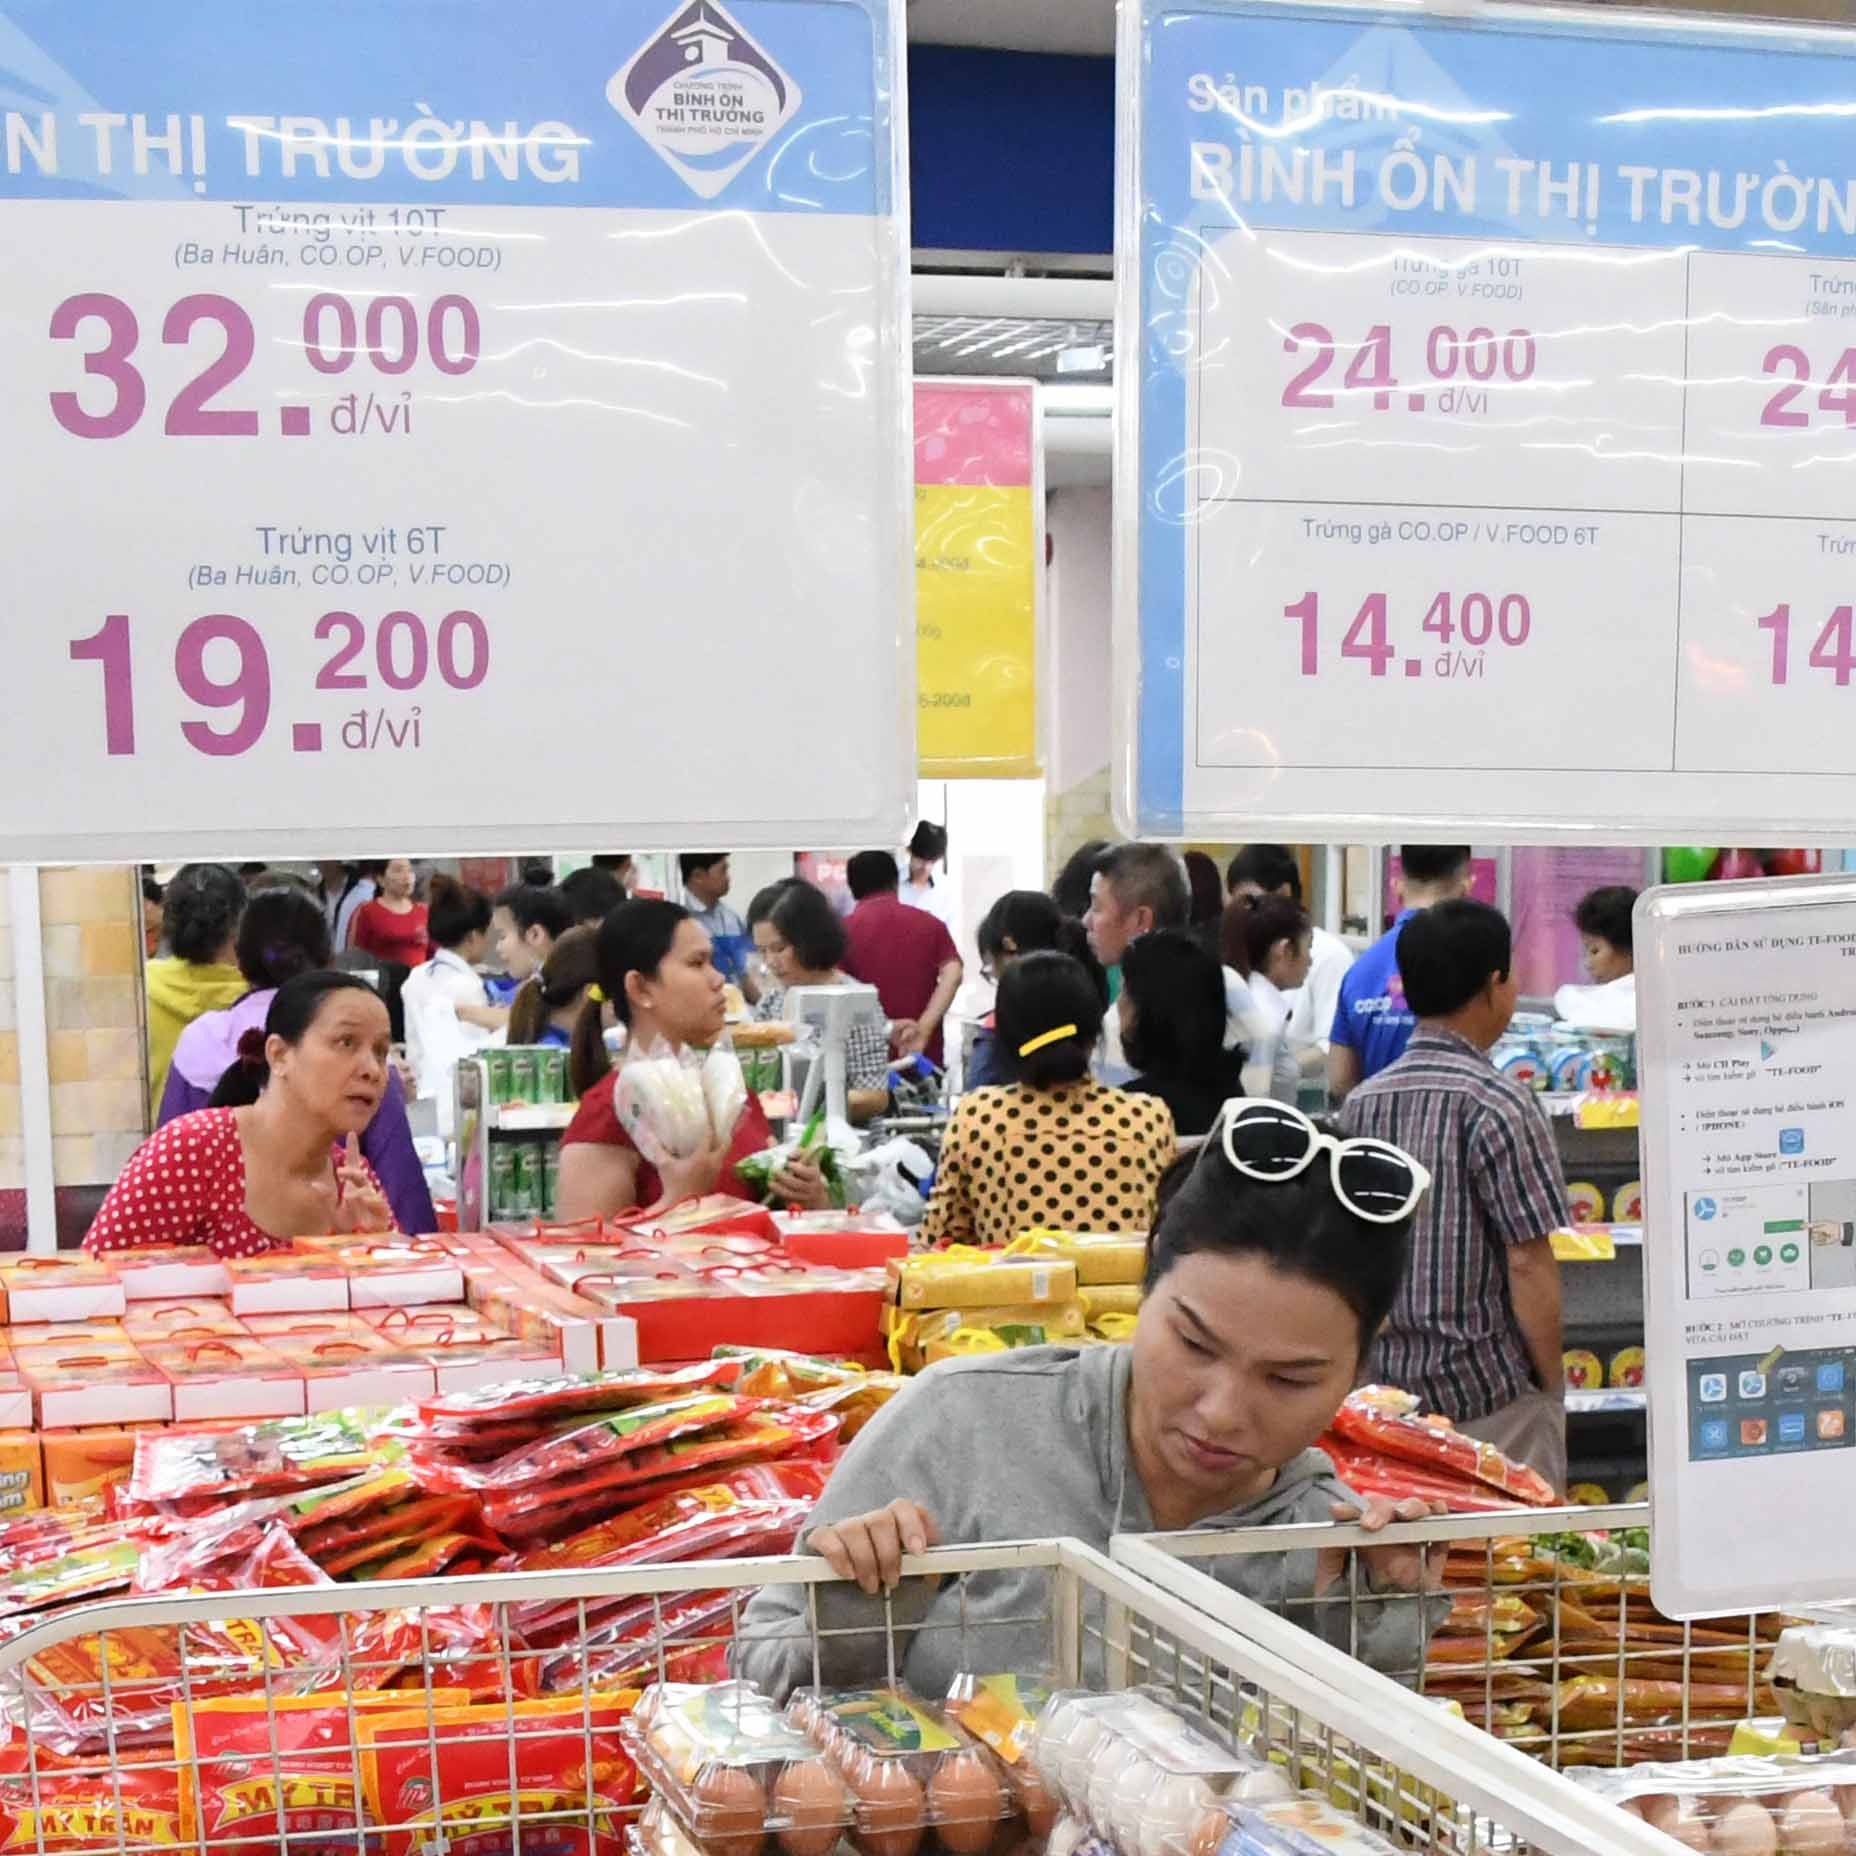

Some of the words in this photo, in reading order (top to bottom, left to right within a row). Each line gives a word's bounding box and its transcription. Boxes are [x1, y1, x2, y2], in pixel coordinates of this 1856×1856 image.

[1187, 72, 1268, 113] Sản
[79, 112, 207, 193] THỊ
[228, 103, 582, 183] TRƯỜNG
[1189, 128, 1355, 207] BÌNH
[1379, 127, 1479, 214] ỔN
[1496, 158, 1601, 236] THỊ
[233, 206, 331, 242] Trứng
[341, 209, 376, 242] vịt
[389, 209, 447, 238] 10T
[175, 244, 214, 269] (Ba
[398, 246, 503, 271] V.FOOD)
[49, 292, 482, 438] 32.000
[330, 390, 413, 438] đ/vỉ
[254, 525, 352, 562] Trứng
[362, 527, 397, 561] vịt
[406, 526, 448, 555] 6T
[1302, 518, 1364, 544] Trứng
[1368, 521, 1393, 546] gà
[1397, 520, 1470, 542] CO.OP
[1487, 523, 1570, 546] V.FOOD
[1573, 525, 1601, 546] 6T
[188, 565, 227, 588] (Ba
[235, 564, 302, 588] Huân,
[311, 564, 398, 588] CO.OP,
[408, 563, 512, 588] V.FOOD)
[1283, 590, 1532, 677] 14.400
[70, 610, 491, 757] 19.200
[1433, 649, 1486, 679] đ/vỉ
[341, 705, 422, 750] đ/vỉ
